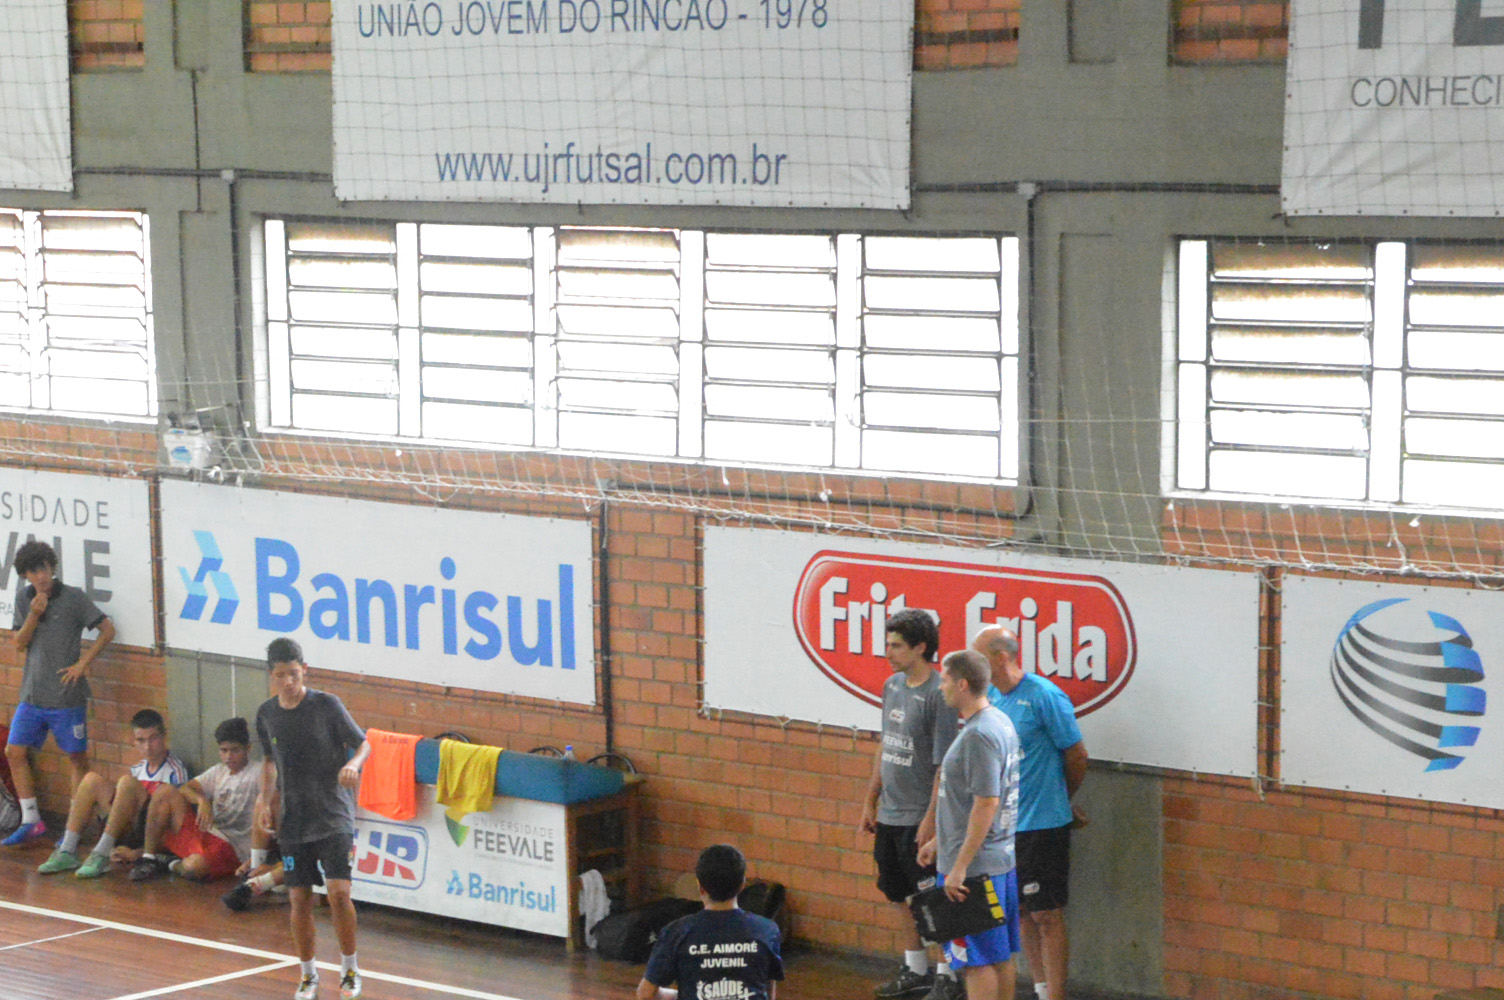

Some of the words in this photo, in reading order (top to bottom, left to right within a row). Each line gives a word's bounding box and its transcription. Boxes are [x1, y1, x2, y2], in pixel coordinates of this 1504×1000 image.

[452, 0, 547, 36] JOVEM
[559, 0, 600, 33] DO
[760, 0, 828, 29] 1978
[435, 143, 787, 193] www.ujrfutsal.com.br
[254, 537, 576, 670] Banrisul
[820, 576, 941, 663] Fri
[473, 814, 554, 839] UNIVERSIDADE
[352, 828, 418, 881] JR
[474, 828, 554, 862] FEEVALE
[469, 872, 556, 913] Banrisul
[689, 944, 711, 955] C.E.
[713, 940, 758, 954] AIMORÉ
[700, 957, 748, 968] JUVENIL
[704, 977, 744, 999] SAÚDE
